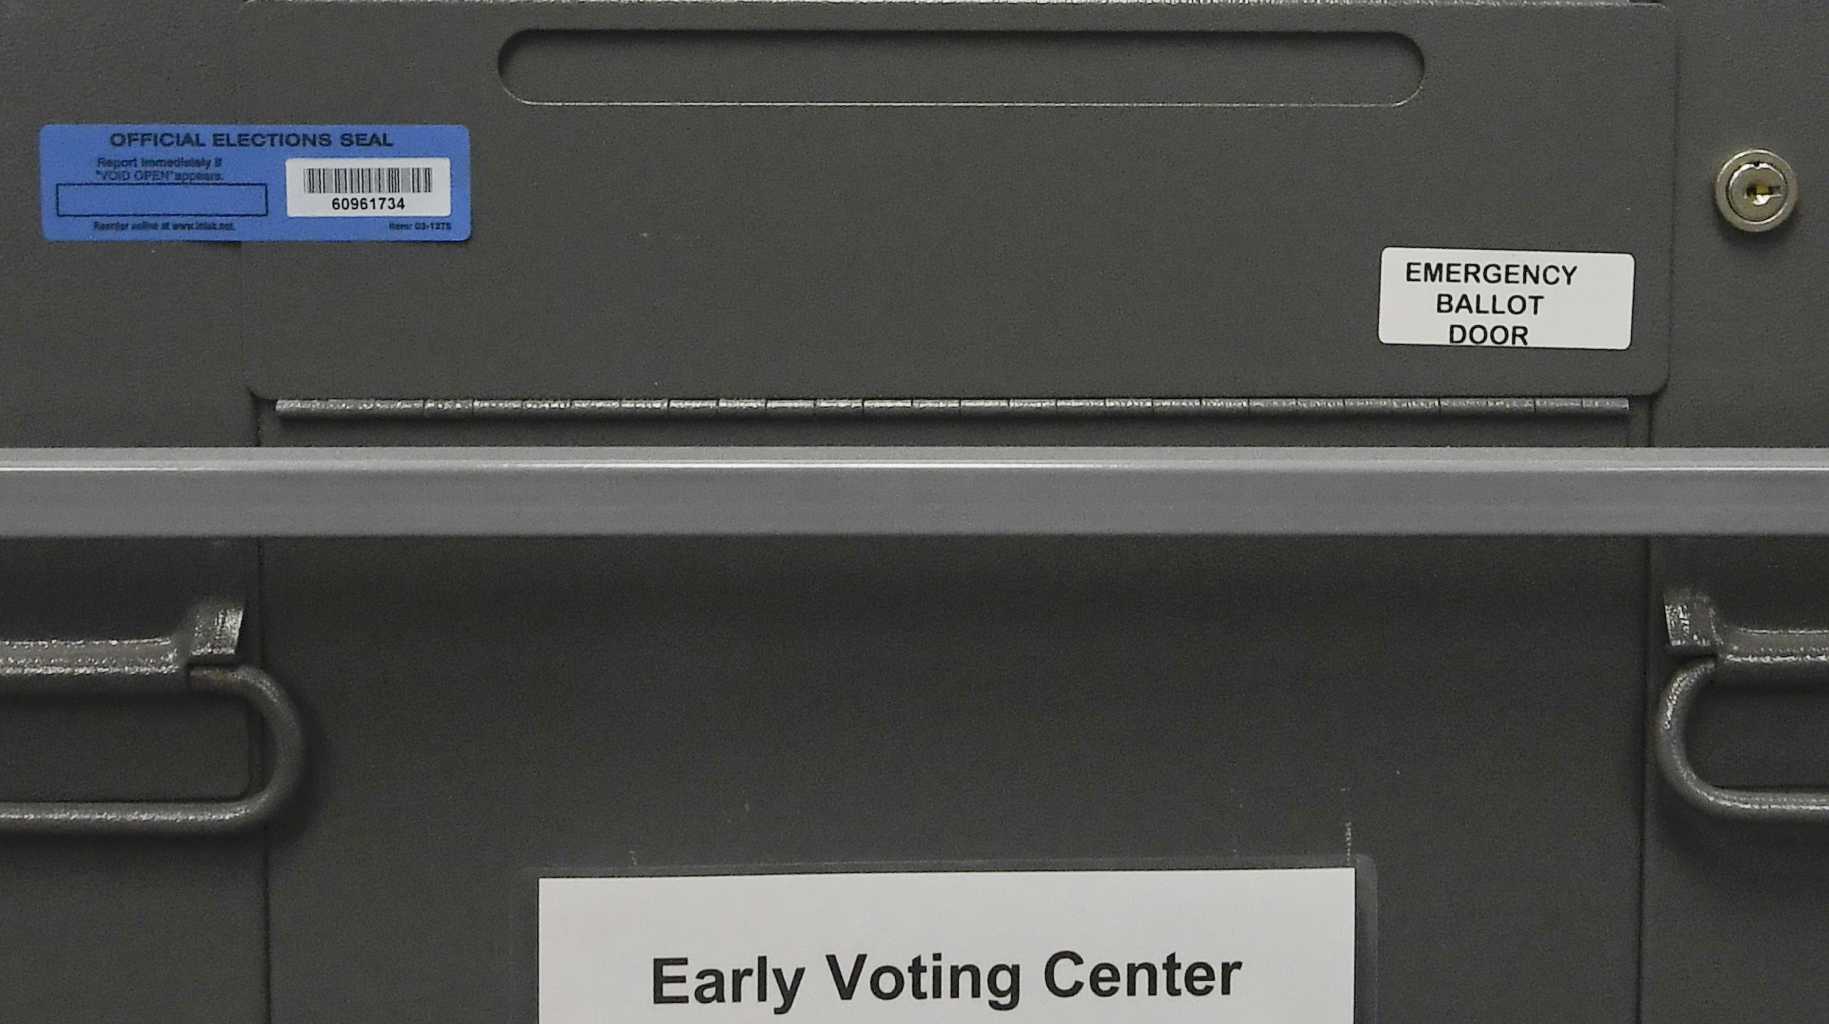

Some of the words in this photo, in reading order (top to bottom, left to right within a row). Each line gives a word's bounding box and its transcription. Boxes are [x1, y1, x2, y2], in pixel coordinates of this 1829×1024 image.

[110, 132, 206, 147] OFFICIAL
[212, 132, 332, 147] ELECTIONS
[340, 132, 394, 147] SEAL
[97, 157, 138, 170] Report
[331, 197, 405, 210] 60961734
[1406, 262, 1578, 286] EMERGENCY
[1436, 294, 1544, 315] BALLOT
[1449, 324, 1528, 346] DOOR
[652, 956, 806, 1015] Early
[826, 953, 1021, 1012] Voting
[1044, 950, 1243, 998] Center
